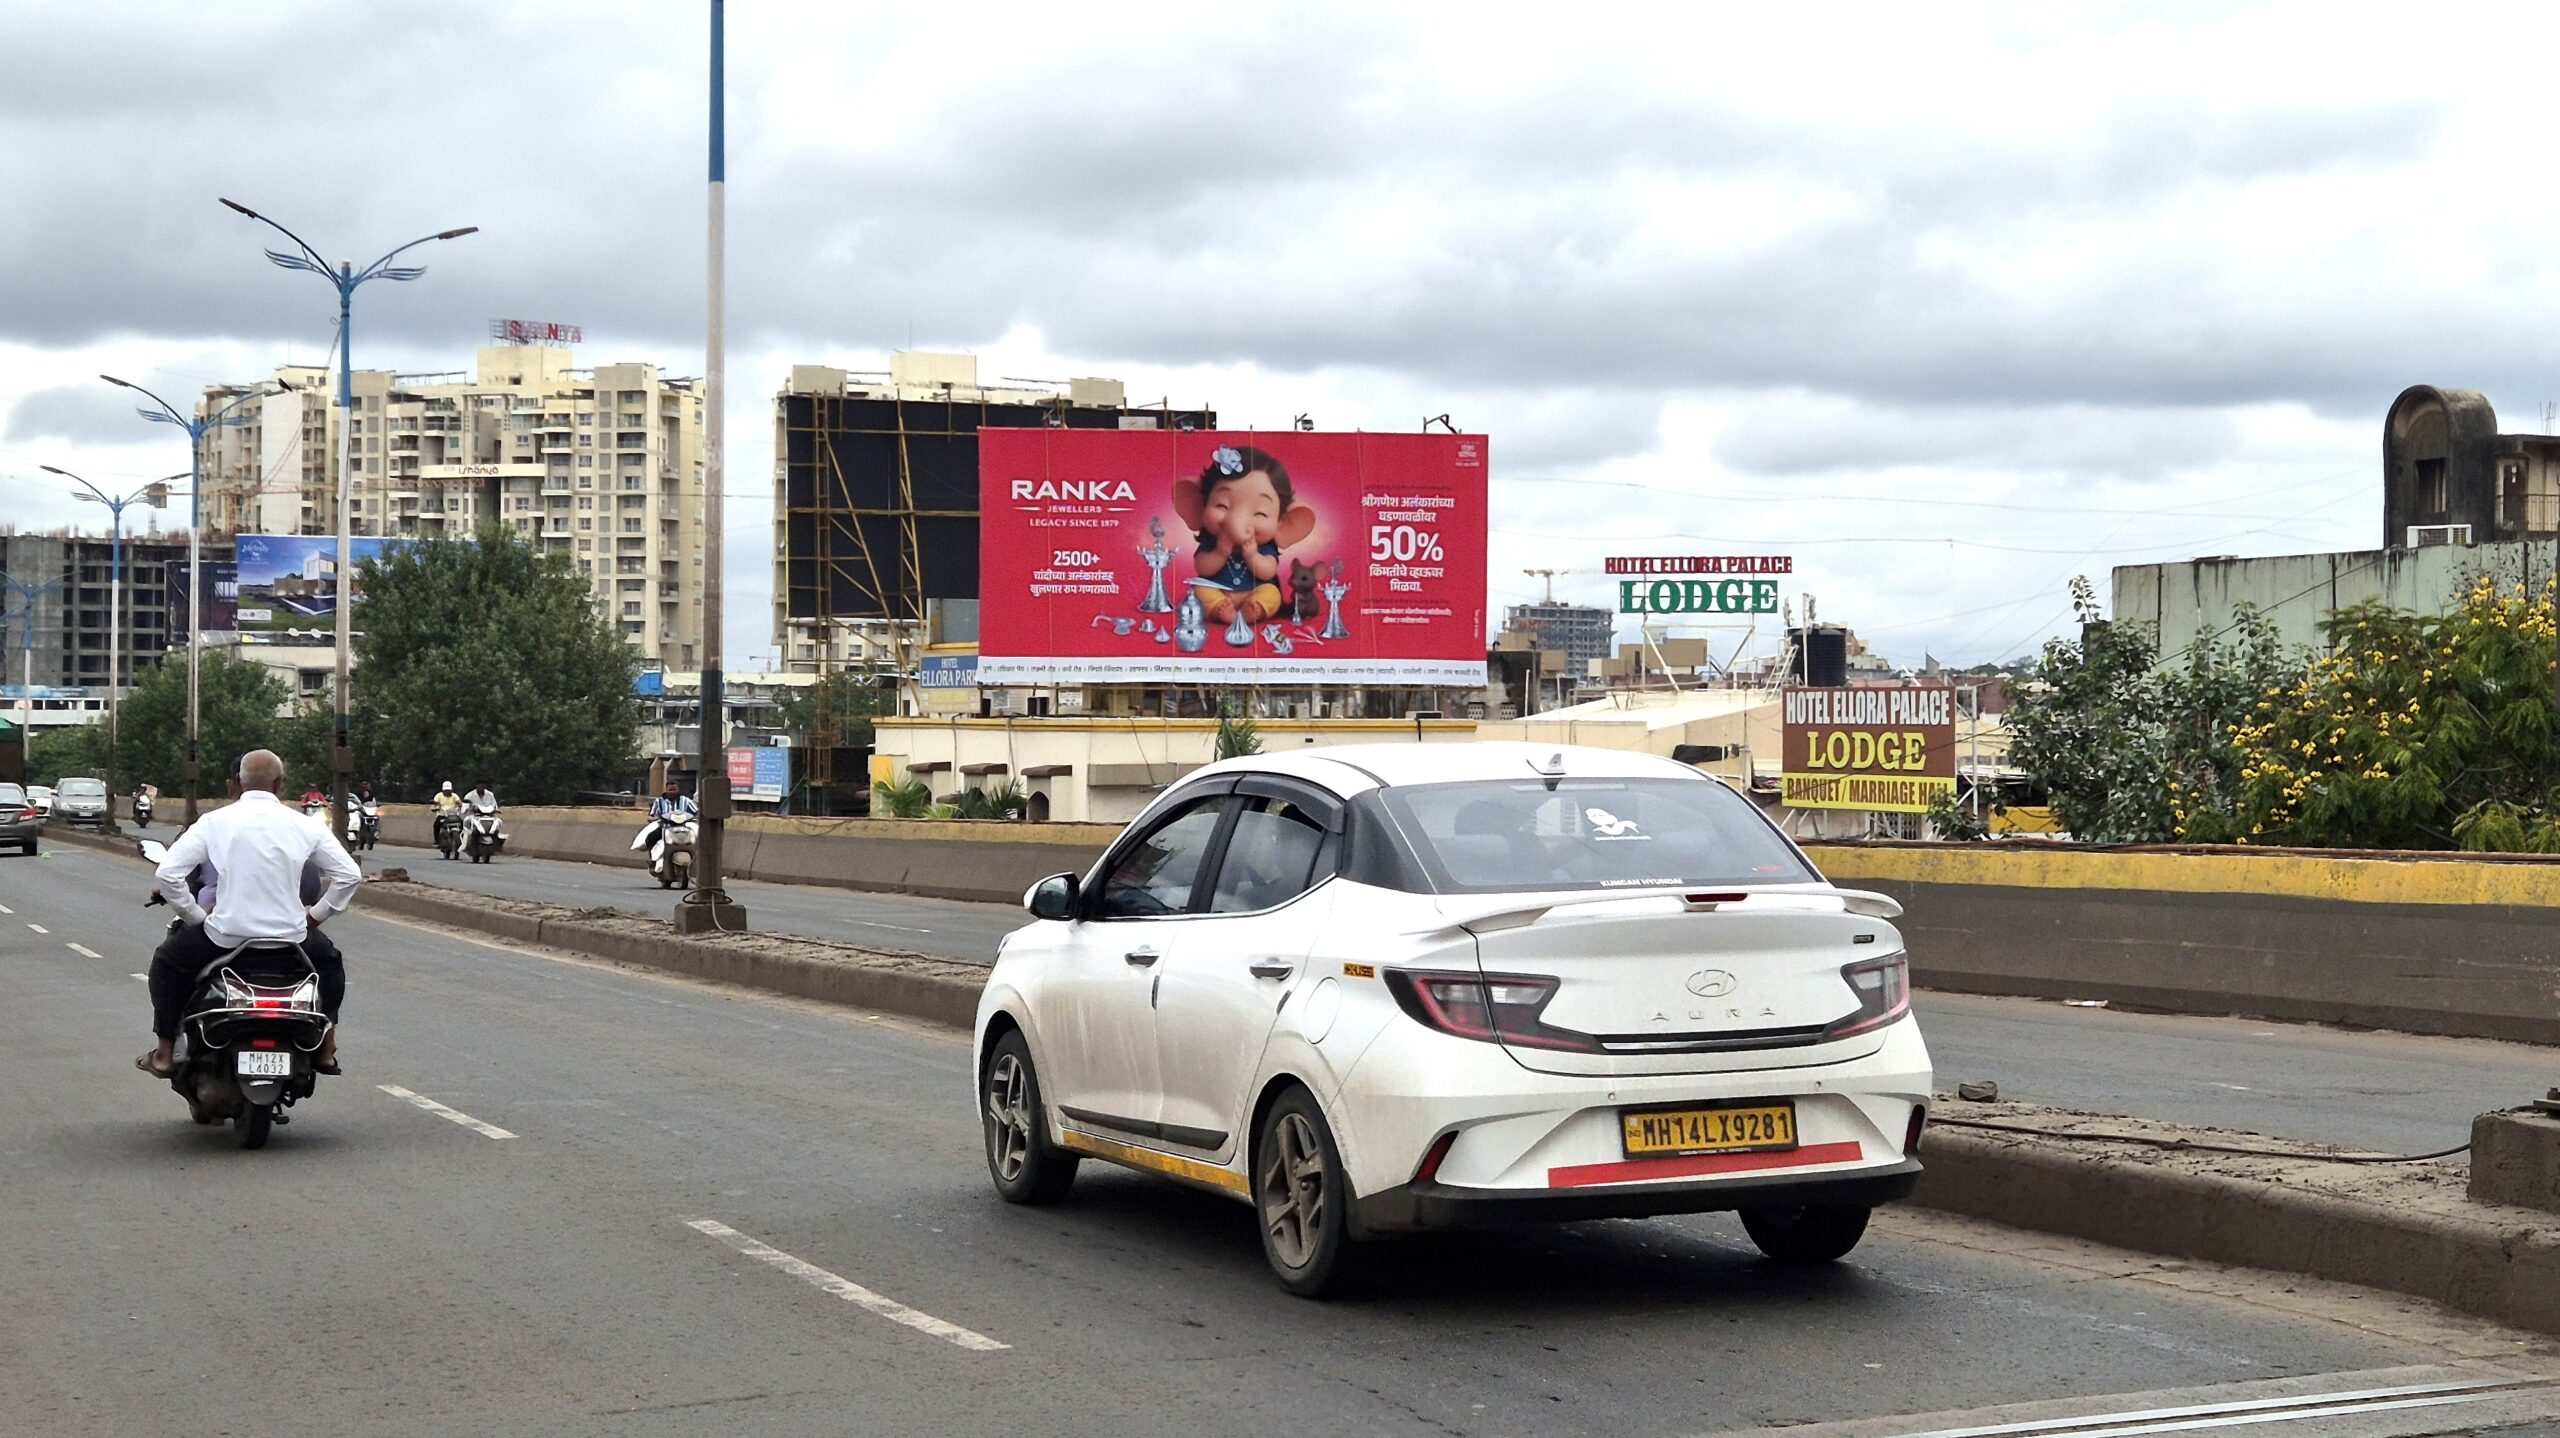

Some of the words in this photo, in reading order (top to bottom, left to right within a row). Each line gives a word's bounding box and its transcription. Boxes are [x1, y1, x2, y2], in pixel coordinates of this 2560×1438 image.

[1011, 480, 1136, 501] RANKA
[1047, 505, 1102, 513] JEWELLERS
[1029, 518, 1067, 527] LEGACY
[1069, 518, 1098, 527] SINCE
[1371, 525, 1444, 562] 50%
[1053, 551, 1100, 566] 2500+
[1605, 557, 1655, 574] HOTEL
[1660, 556, 1722, 573] ELLORA
[1726, 556, 1792, 573] PALACE
[1620, 579, 1778, 614] LODGE
[941, 658, 958, 669] HOTEL
[921, 670, 954, 687] ELLORA
[1786, 691, 1830, 724] HOTEL
[1833, 691, 1887, 725] ELLORA
[1891, 691, 1950, 726] PALACE
[1807, 731, 1926, 770] LODGE
[1787, 778, 1840, 803] BANQUET
[1849, 780, 1916, 805] MARRIAGE
[1650, 1007, 1776, 1022] AURA
[1642, 1112, 1790, 1147] MH14LX9281
